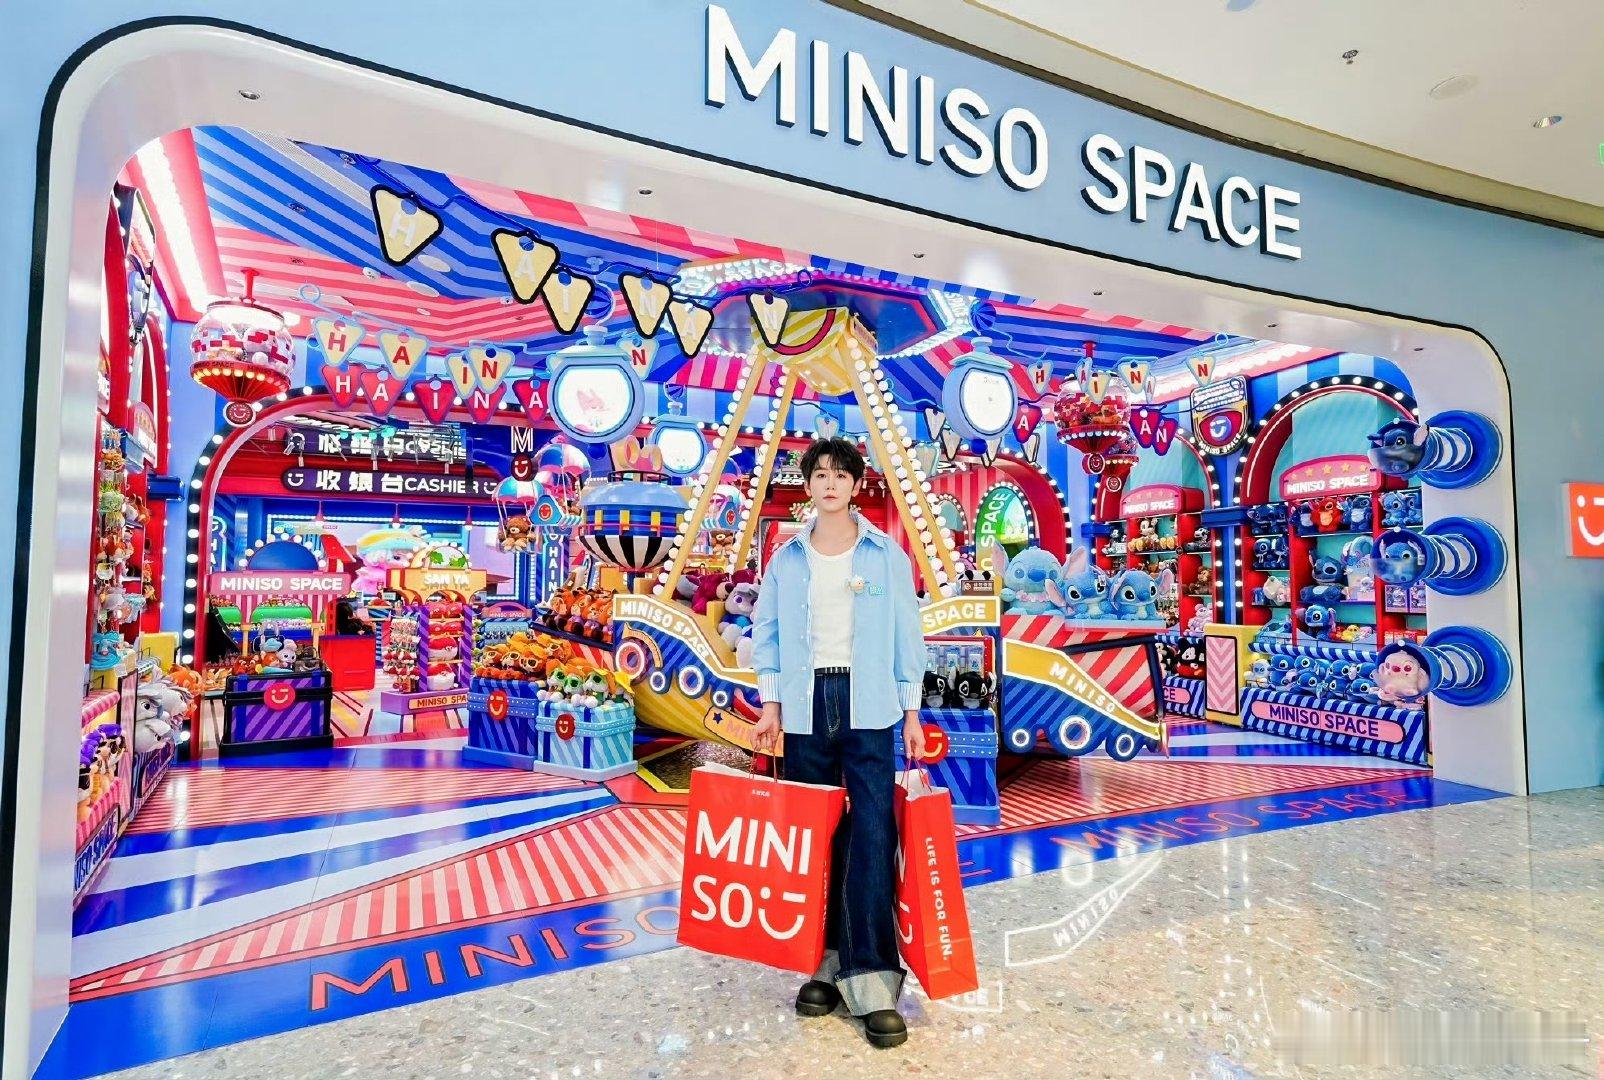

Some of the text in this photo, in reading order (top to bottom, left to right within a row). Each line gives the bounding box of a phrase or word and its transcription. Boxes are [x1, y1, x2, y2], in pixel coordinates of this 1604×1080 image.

[704, 4, 1302, 261] MINISO SPACE
[1329, 474, 1370, 489] SPACE
[981, 493, 1012, 548] SPACE
[220, 577, 344, 591] MINISO SPACE
[620, 601, 673, 628] MINISO
[922, 602, 987, 629] SPACE
[416, 697, 448, 708] MINISO
[1049, 661, 1116, 713] MINISO
[1269, 704, 1379, 737] MINISO SPACE
[695, 810, 812, 875] MINI
[1051, 811, 1260, 852] MINISO
[925, 836, 937, 867] LIFE
[930, 871, 940, 886] IS
[933, 889, 947, 920] FOR
[310, 906, 680, 1011] MINISO
